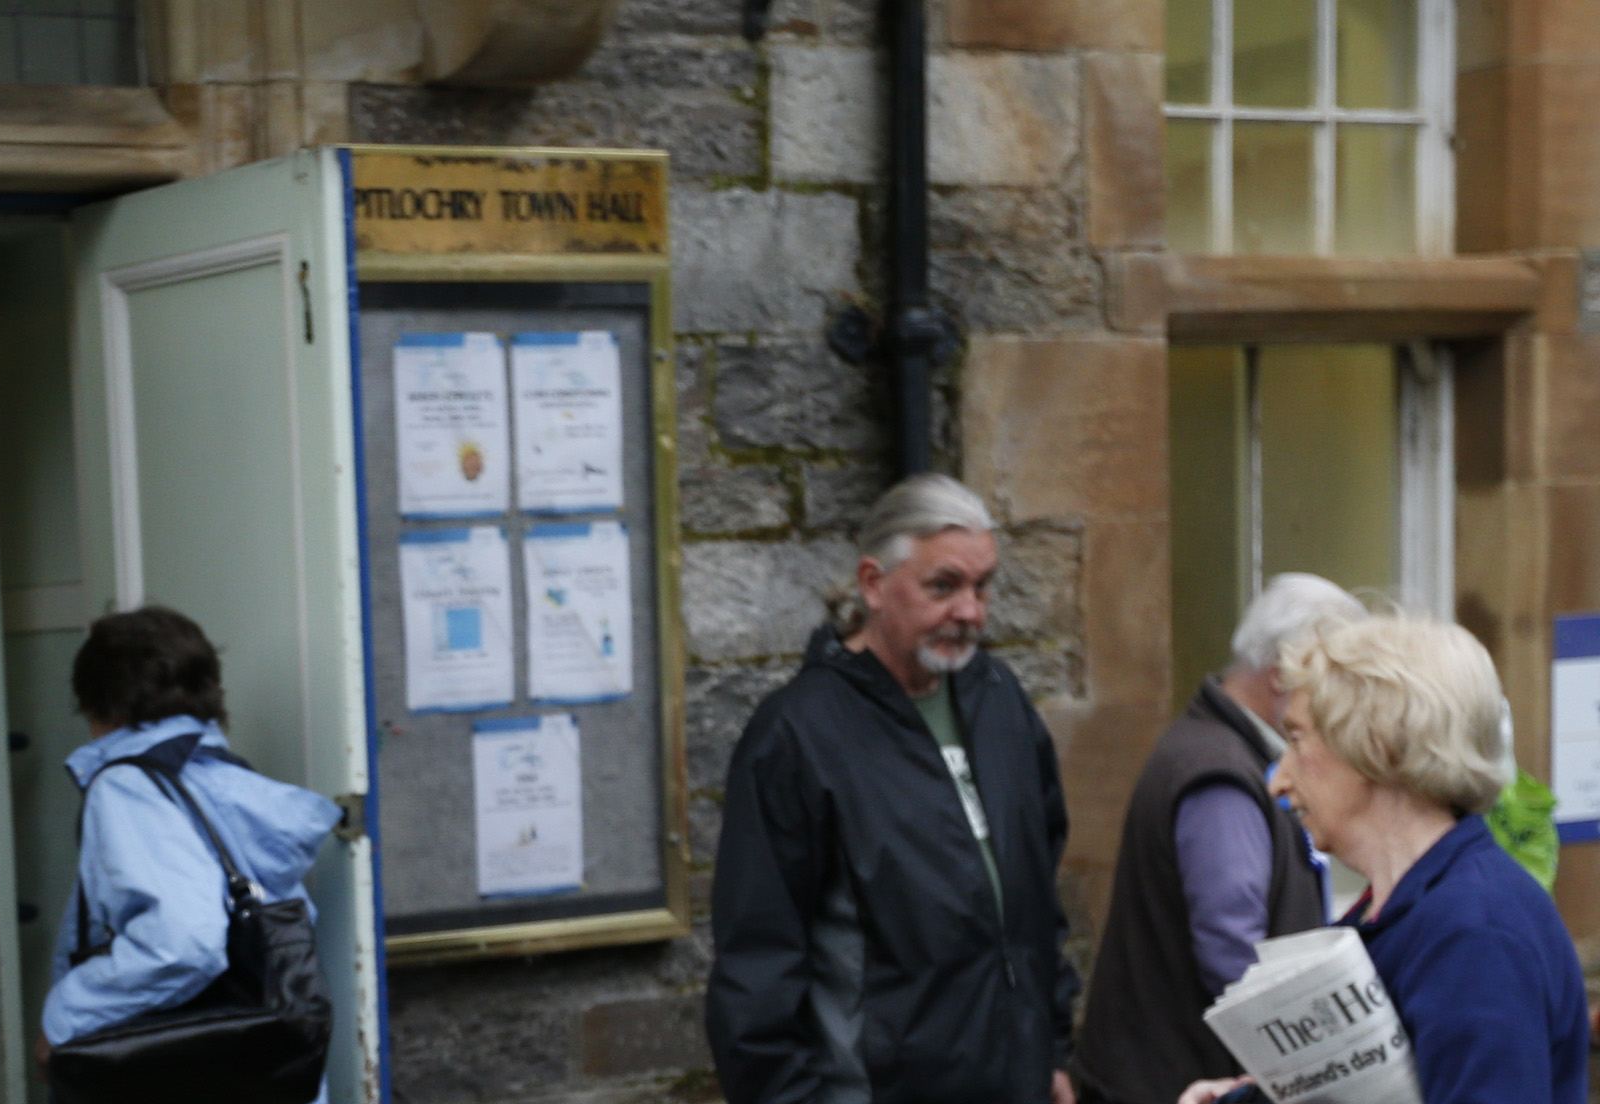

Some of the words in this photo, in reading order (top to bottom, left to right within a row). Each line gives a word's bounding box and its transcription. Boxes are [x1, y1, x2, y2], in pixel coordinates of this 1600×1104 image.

[498, 188, 579, 222] TOWN
[586, 190, 645, 223] HALL
[1256, 1015, 1324, 1057] The
[1349, 1044, 1387, 1073] day
